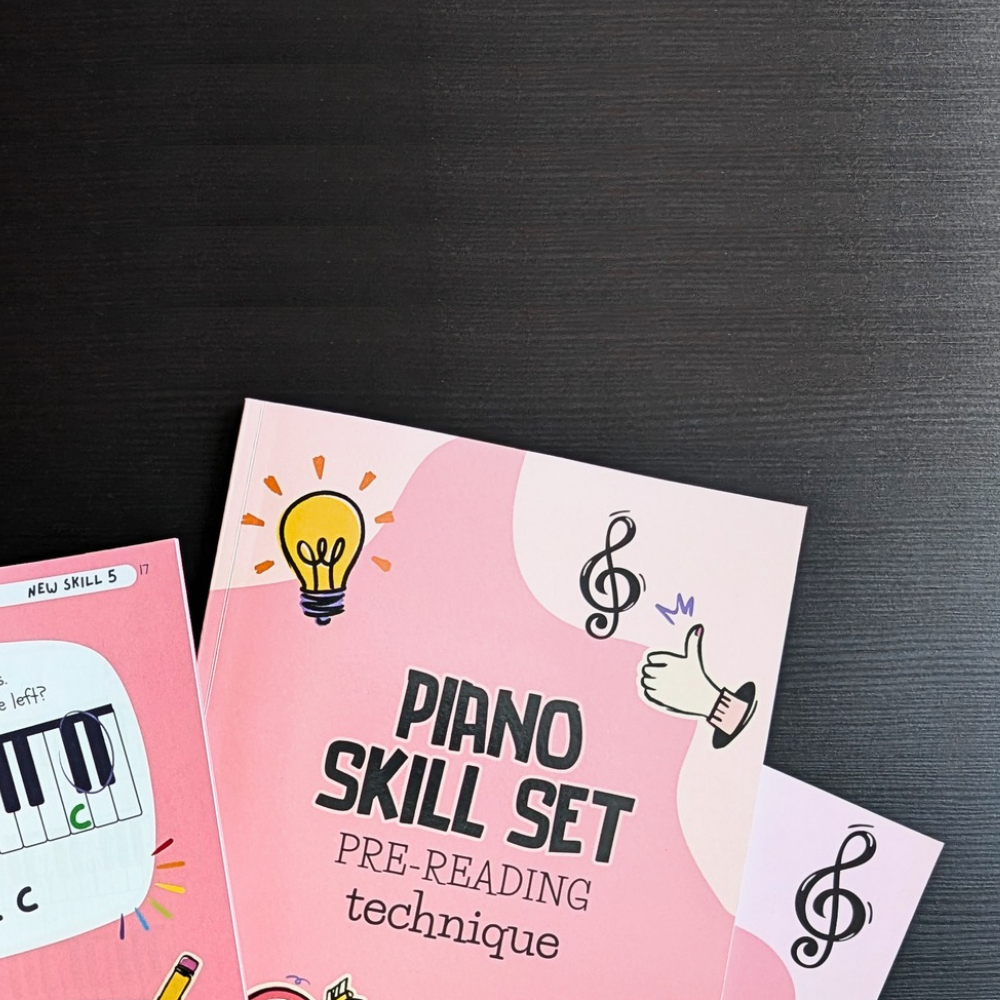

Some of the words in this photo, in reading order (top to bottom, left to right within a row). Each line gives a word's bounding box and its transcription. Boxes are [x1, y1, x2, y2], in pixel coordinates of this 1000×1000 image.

[28, 582, 57, 598] NEW
[64, 575, 102, 590] SKILL
[108, 569, 117, 583] 5
[139, 564, 149, 575] 17
[11, 686, 46, 709] left?
[396, 669, 582, 770] PIANO
[315, 740, 484, 838] SKILL
[507, 778, 635, 863] SET
[70, 804, 91, 829] C
[335, 832, 591, 911] PRE-READING
[17, 886, 38, 912] C
[346, 888, 559, 960] technique
